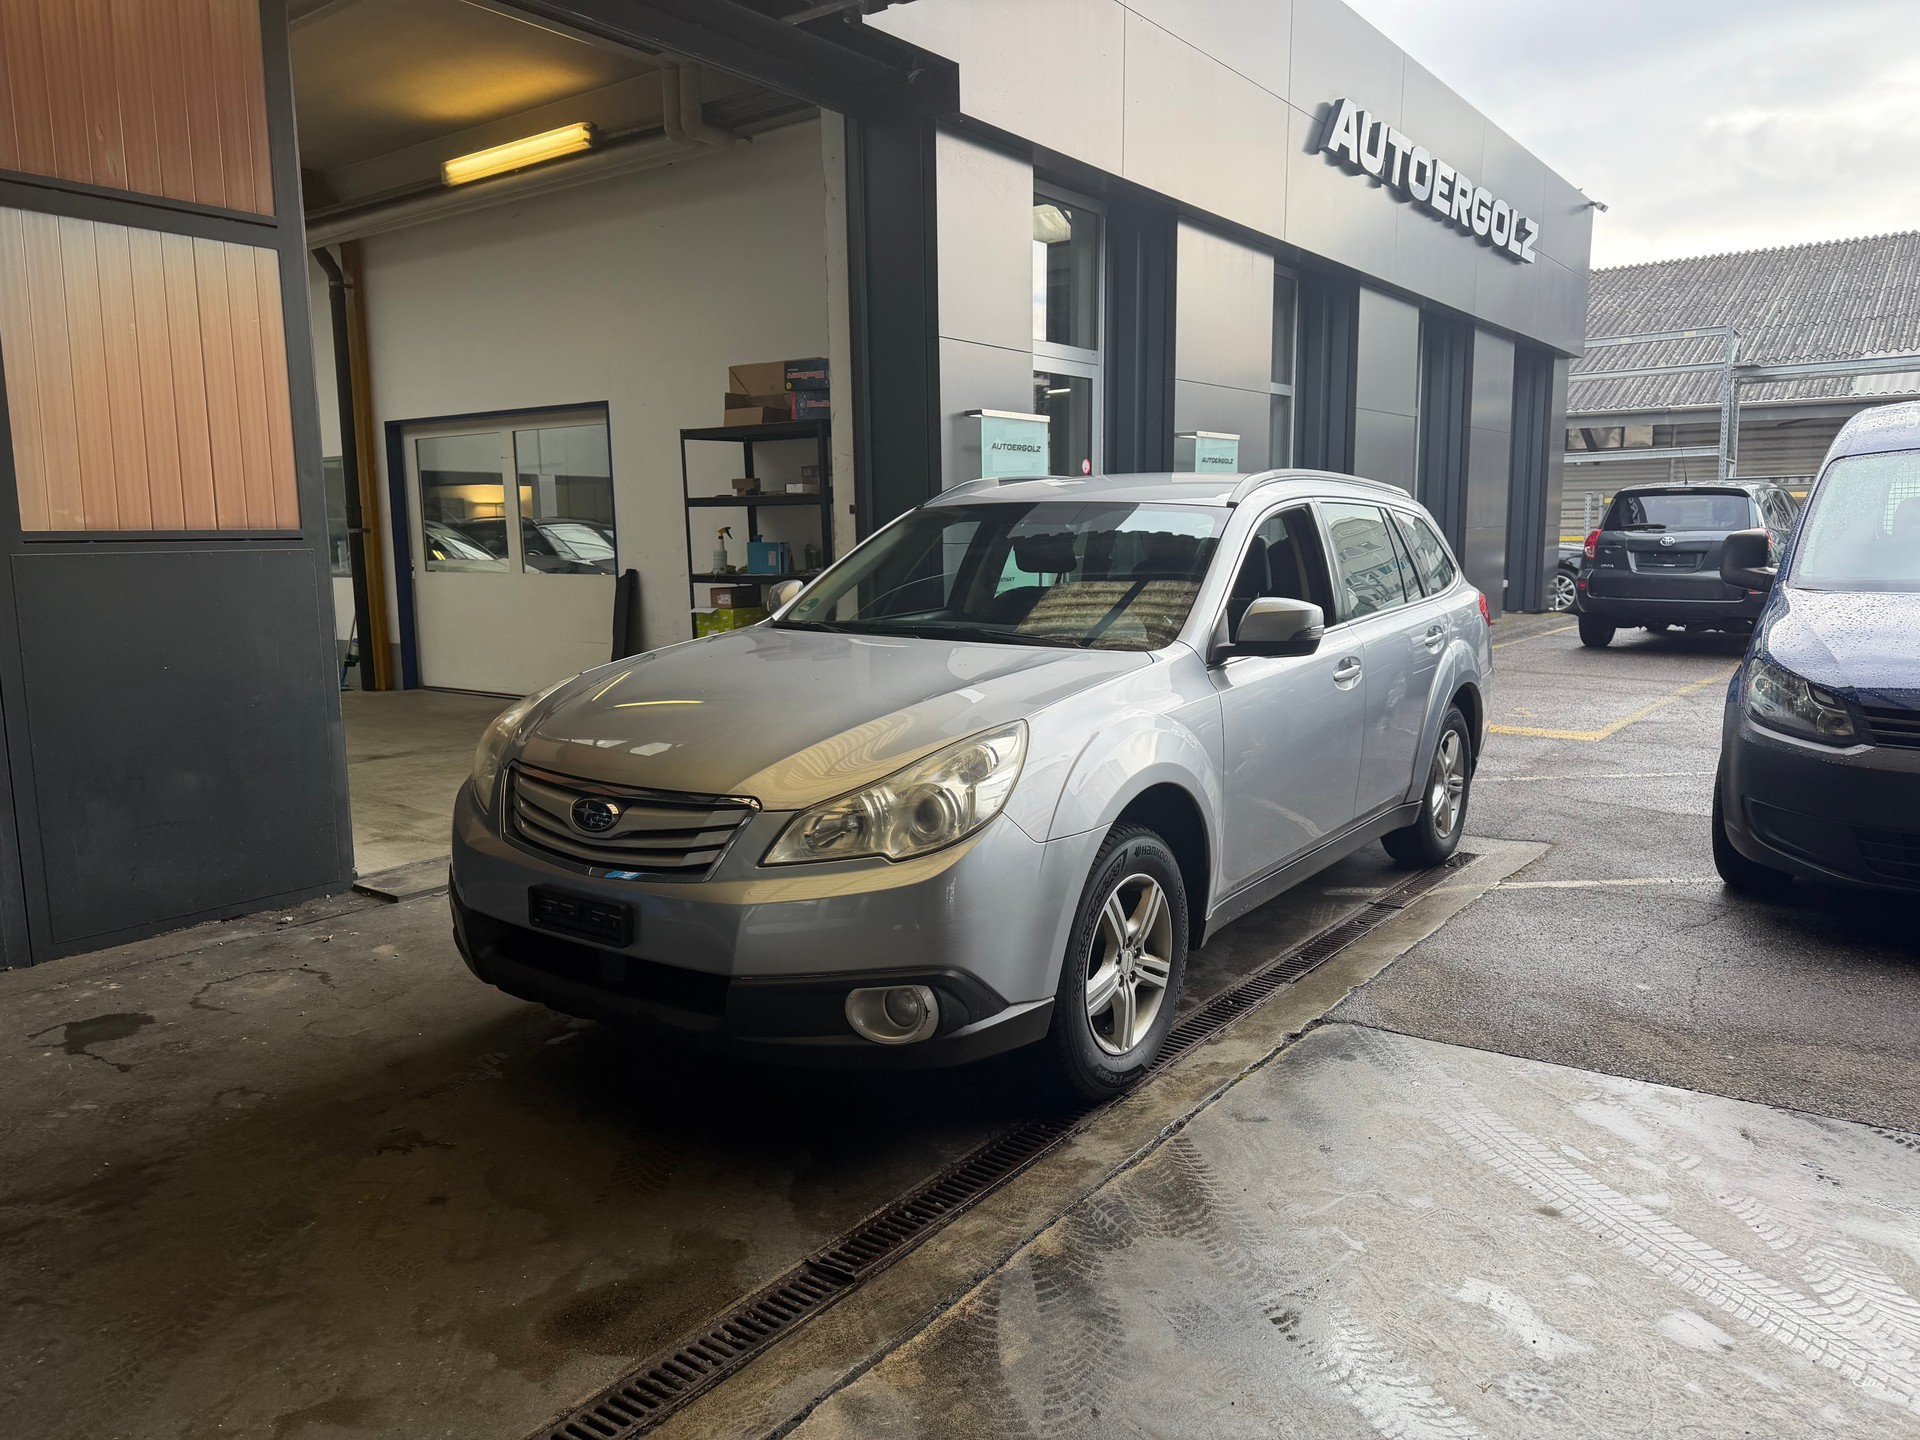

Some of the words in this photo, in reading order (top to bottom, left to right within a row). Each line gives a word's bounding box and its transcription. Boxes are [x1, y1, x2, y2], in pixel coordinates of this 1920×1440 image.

[1320, 97, 1539, 264] AUTOERGOLZ
[991, 442, 1041, 453] AUTOERGOLZ
[1201, 457, 1234, 465] AUTOERGOLZ
